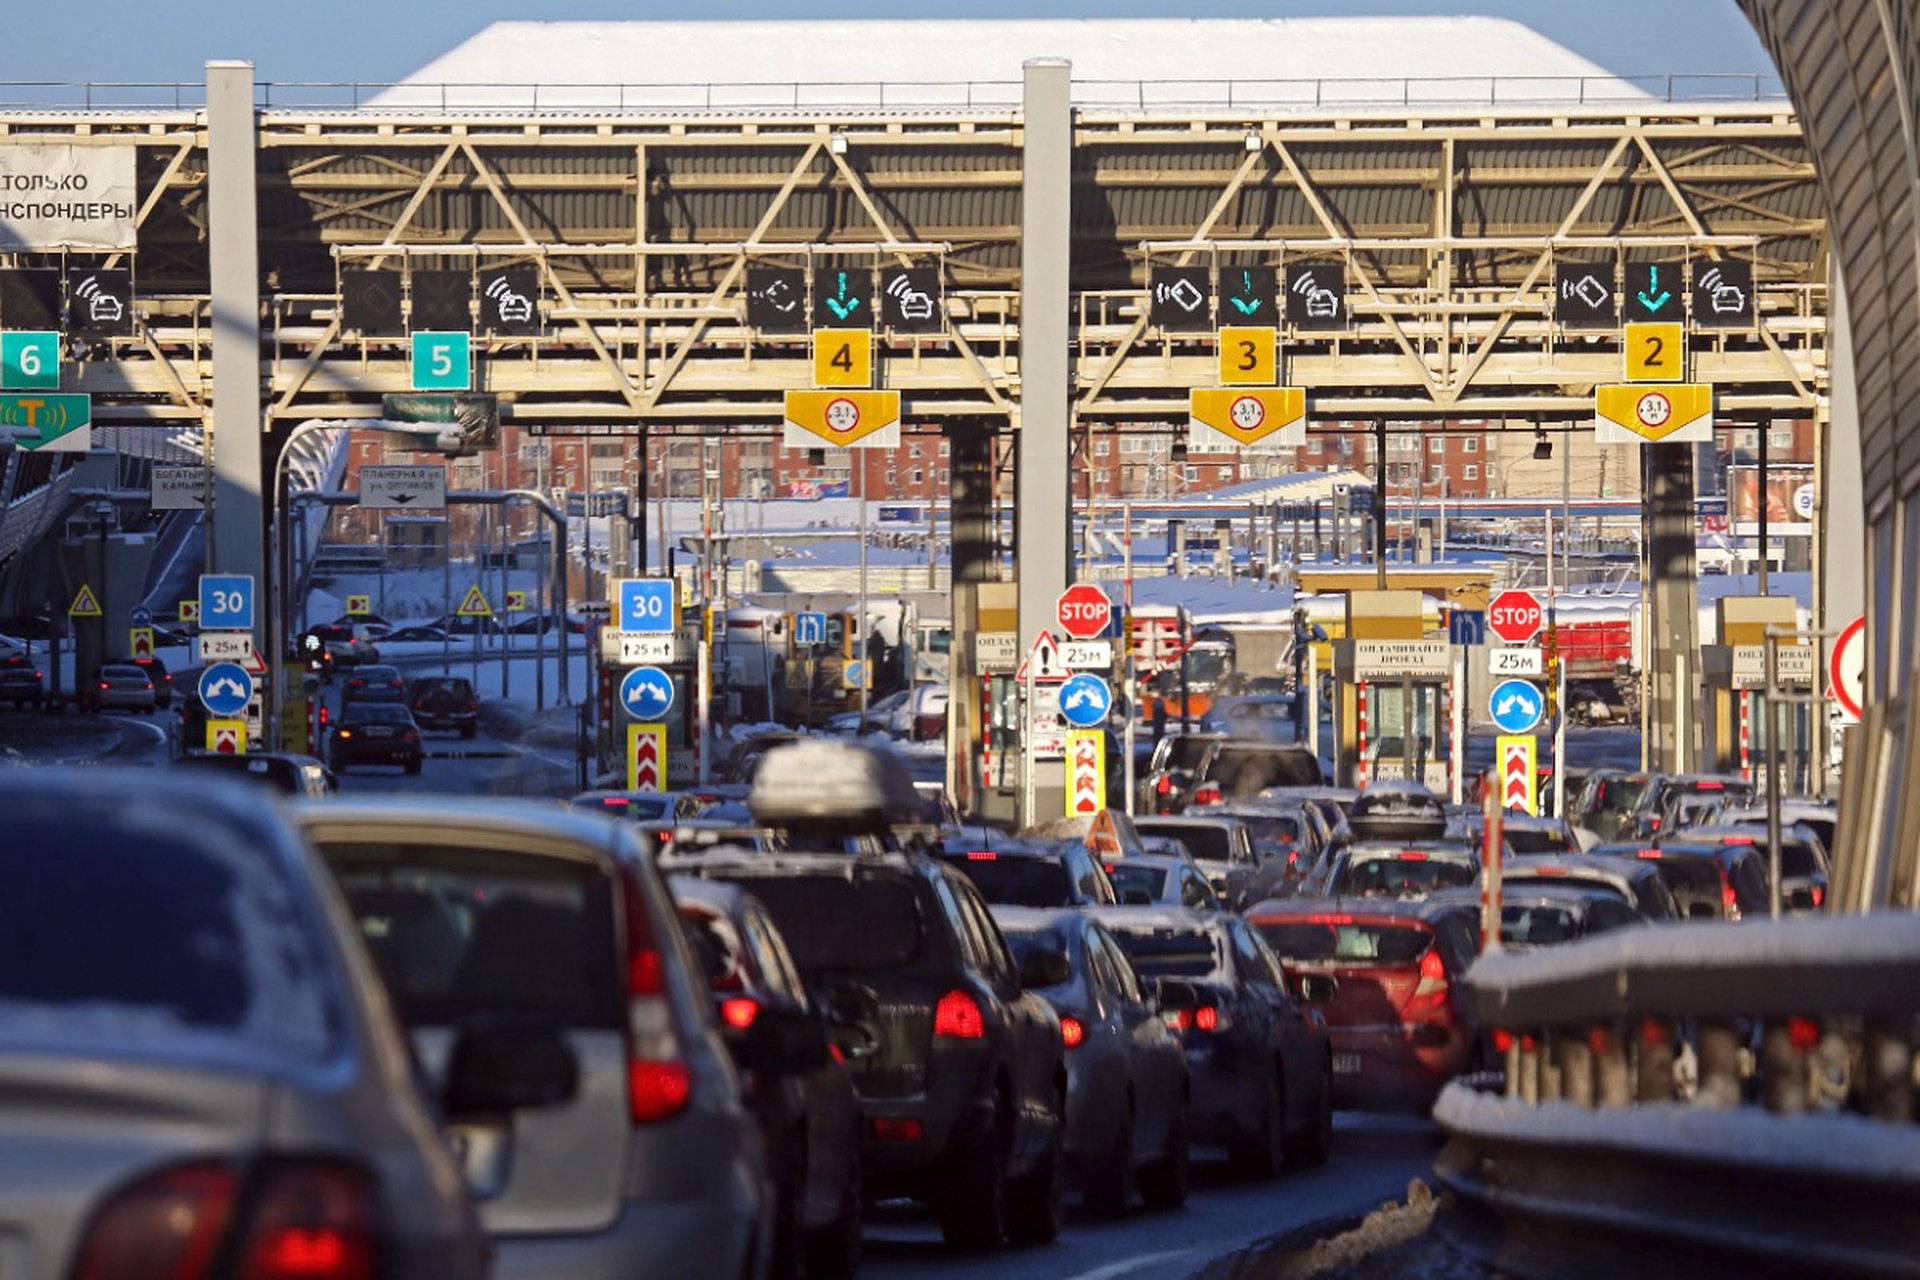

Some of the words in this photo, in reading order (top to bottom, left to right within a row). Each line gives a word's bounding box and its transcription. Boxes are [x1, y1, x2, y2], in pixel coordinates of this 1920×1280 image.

[2, 174, 88, 191] ТОЛЬКО
[20, 345, 41, 376] 6
[432, 345, 452, 376] 5
[830, 343, 853, 372] 4
[1237, 340, 1258, 371] 3
[1644, 335, 1664, 367] 2
[156, 469, 214, 480] БОГАТЫР
[212, 591, 243, 614] 30
[632, 595, 663, 618] 30
[1061, 603, 1107, 620] STOP
[1493, 608, 1539, 625] STOP
[633, 644, 649, 656] 25
[1359, 644, 1447, 655] ОПЛАЧИВАЙТЕ
[1381, 655, 1425, 666] ПРОЕЗД
